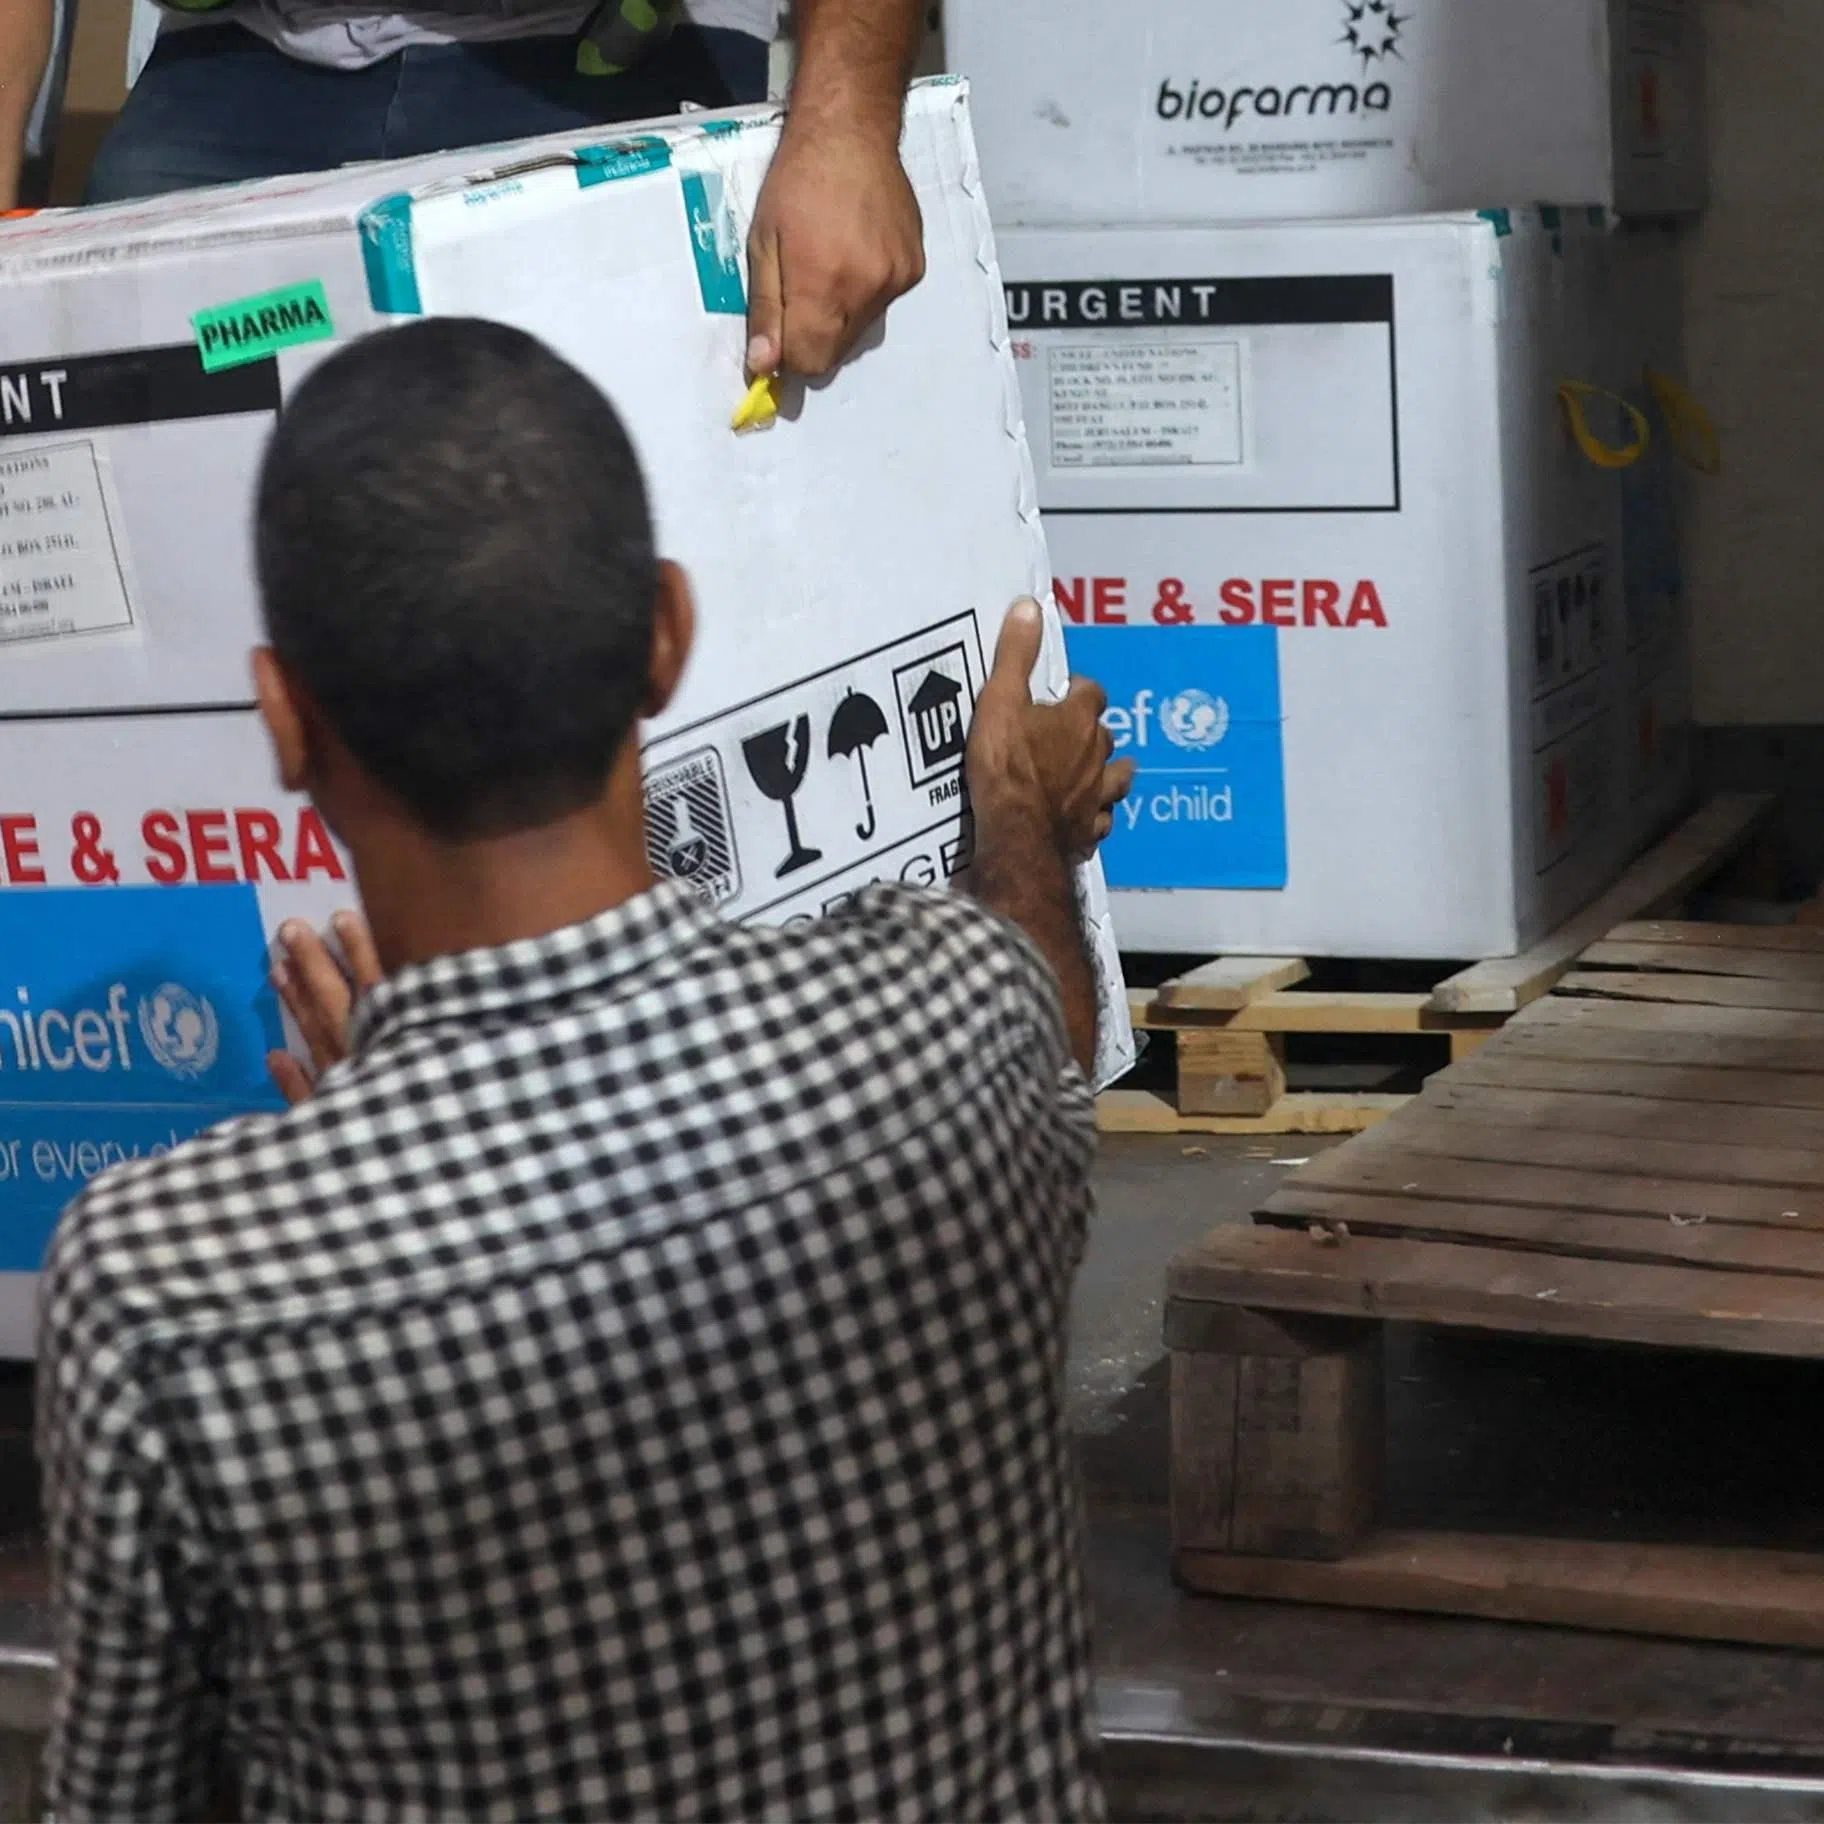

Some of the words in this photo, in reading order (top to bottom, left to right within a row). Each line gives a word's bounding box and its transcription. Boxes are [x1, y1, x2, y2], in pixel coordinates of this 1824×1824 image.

[1156, 78, 1393, 130] biofarma
[199, 295, 327, 355] PHARMA
[1008, 285, 1217, 323] URGENT
[1153, 578, 1195, 625] &
[1219, 578, 1389, 630] SERA
[919, 700, 958, 753] UP
[1150, 786, 1232, 824] child
[71, 811, 120, 887] &
[141, 806, 348, 883] SERA
